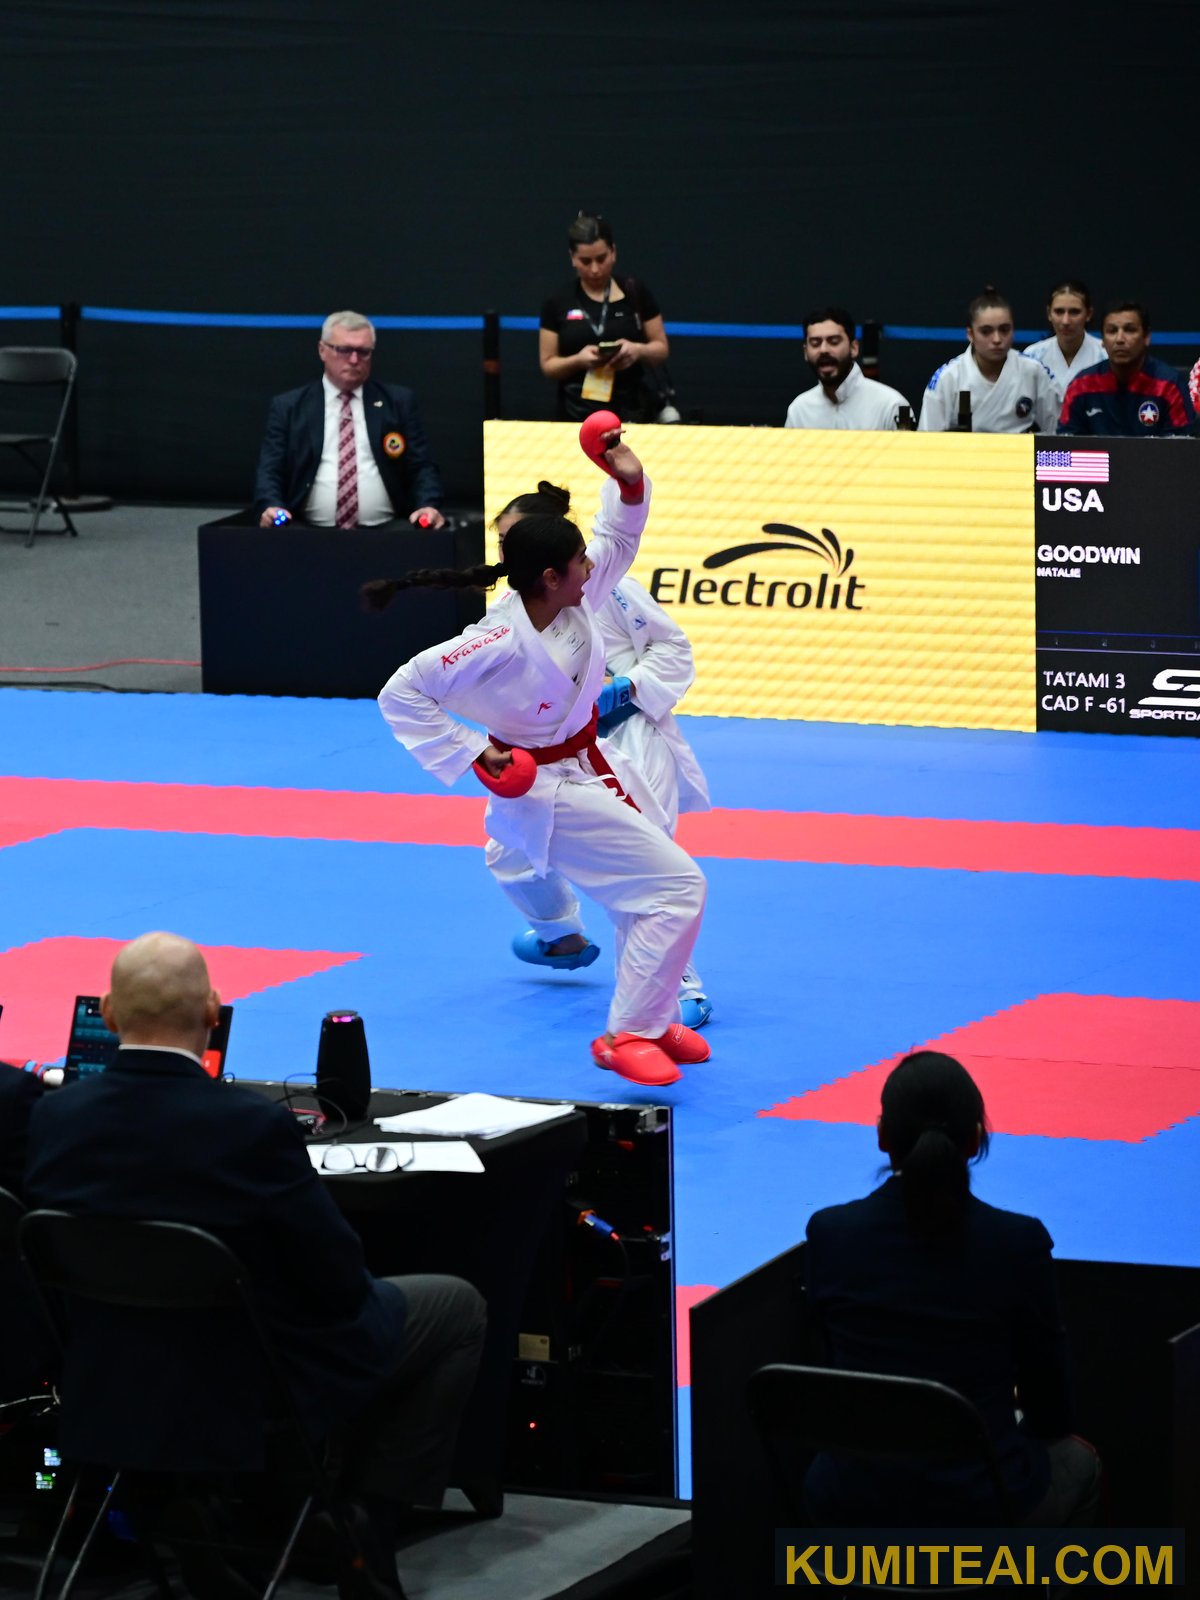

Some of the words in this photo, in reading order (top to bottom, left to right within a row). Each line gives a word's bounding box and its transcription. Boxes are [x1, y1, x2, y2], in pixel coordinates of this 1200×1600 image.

[1042, 487, 1104, 512] USA
[1037, 544, 1141, 565] GOODWIN
[1036, 567, 1082, 579] NATALIE
[650, 567, 866, 610] Electrolit
[440, 625, 511, 672] Arawaza
[1043, 670, 1110, 689] TATAMI
[1115, 672, 1126, 690] 3
[1041, 694, 1079, 712] CAD
[1085, 696, 1094, 712] F
[1098, 697, 1126, 714] -61
